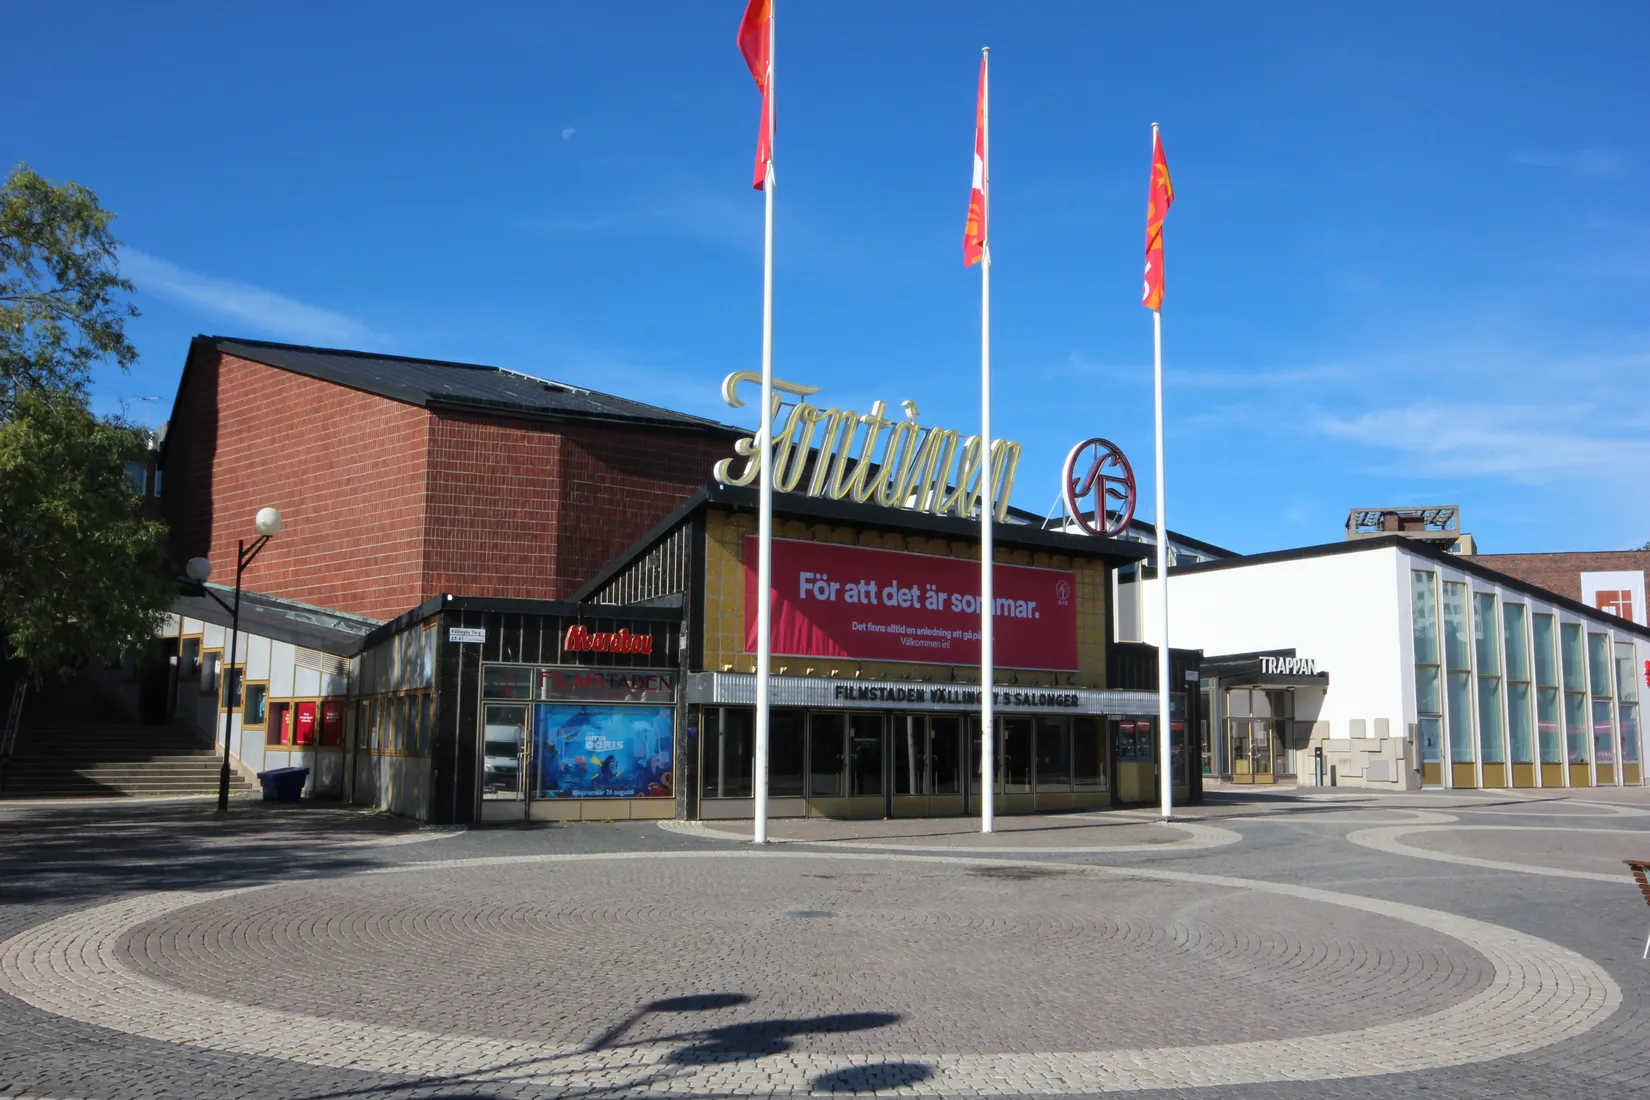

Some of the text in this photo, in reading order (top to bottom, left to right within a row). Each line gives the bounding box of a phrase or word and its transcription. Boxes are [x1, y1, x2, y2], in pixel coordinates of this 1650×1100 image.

[800, 571, 840, 601] För
[844, 578, 878, 605] att
[882, 580, 921, 608] det
[925, 584, 948, 610] är
[564, 624, 653, 655] Marabou
[852, 621, 866, 631] Det
[867, 622, 886, 632] finns
[887, 623, 906, 634] alltid
[906, 627, 915, 635] en
[916, 626, 951, 639] anledning
[952, 630, 962, 639] att
[963, 631, 973, 641] gå
[900, 636, 941, 649] Välkommen
[1259, 656, 1317, 675] TRAPPAN
[540, 671, 673, 691] FILMSTADEN
[835, 685, 925, 703] FILMSTADEN
[930, 687, 999, 706] VÄLLINGY
[1014, 692, 1079, 708] SALONGER
[586, 740, 624, 750] DORIS
